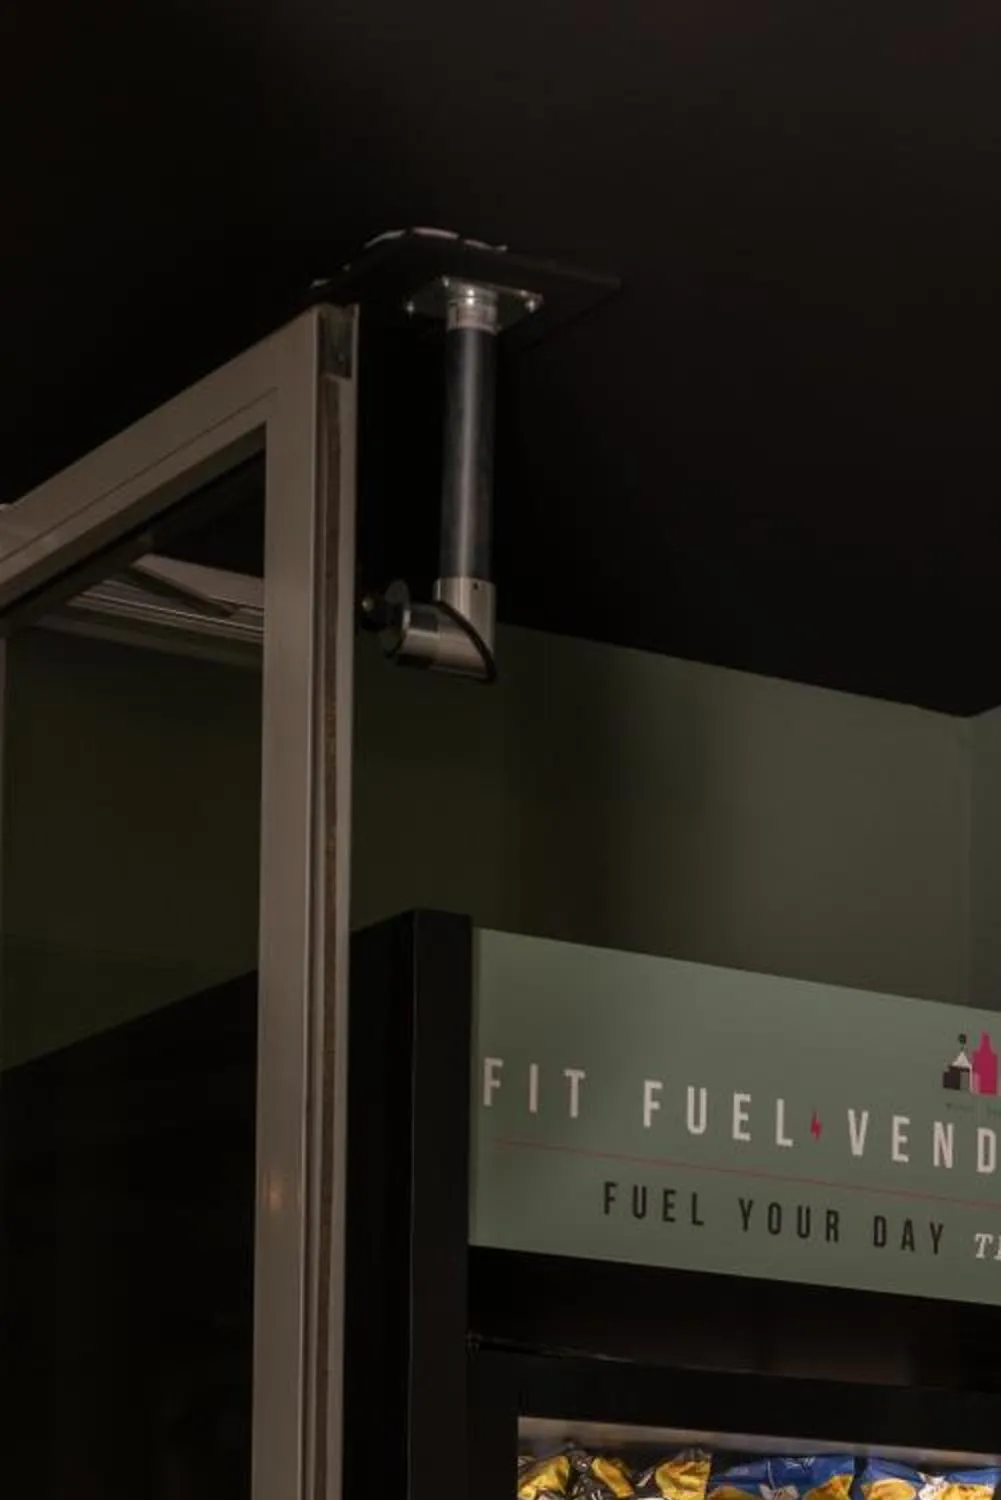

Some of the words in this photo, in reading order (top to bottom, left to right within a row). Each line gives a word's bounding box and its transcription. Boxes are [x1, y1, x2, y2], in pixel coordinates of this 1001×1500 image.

[482, 1056, 587, 1119] FIT
[642, 1080, 793, 1148] FUEL
[603, 1180, 706, 1227] FUEL
[738, 1197, 841, 1243] YOUR
[872, 1214, 946, 1255] DAY
